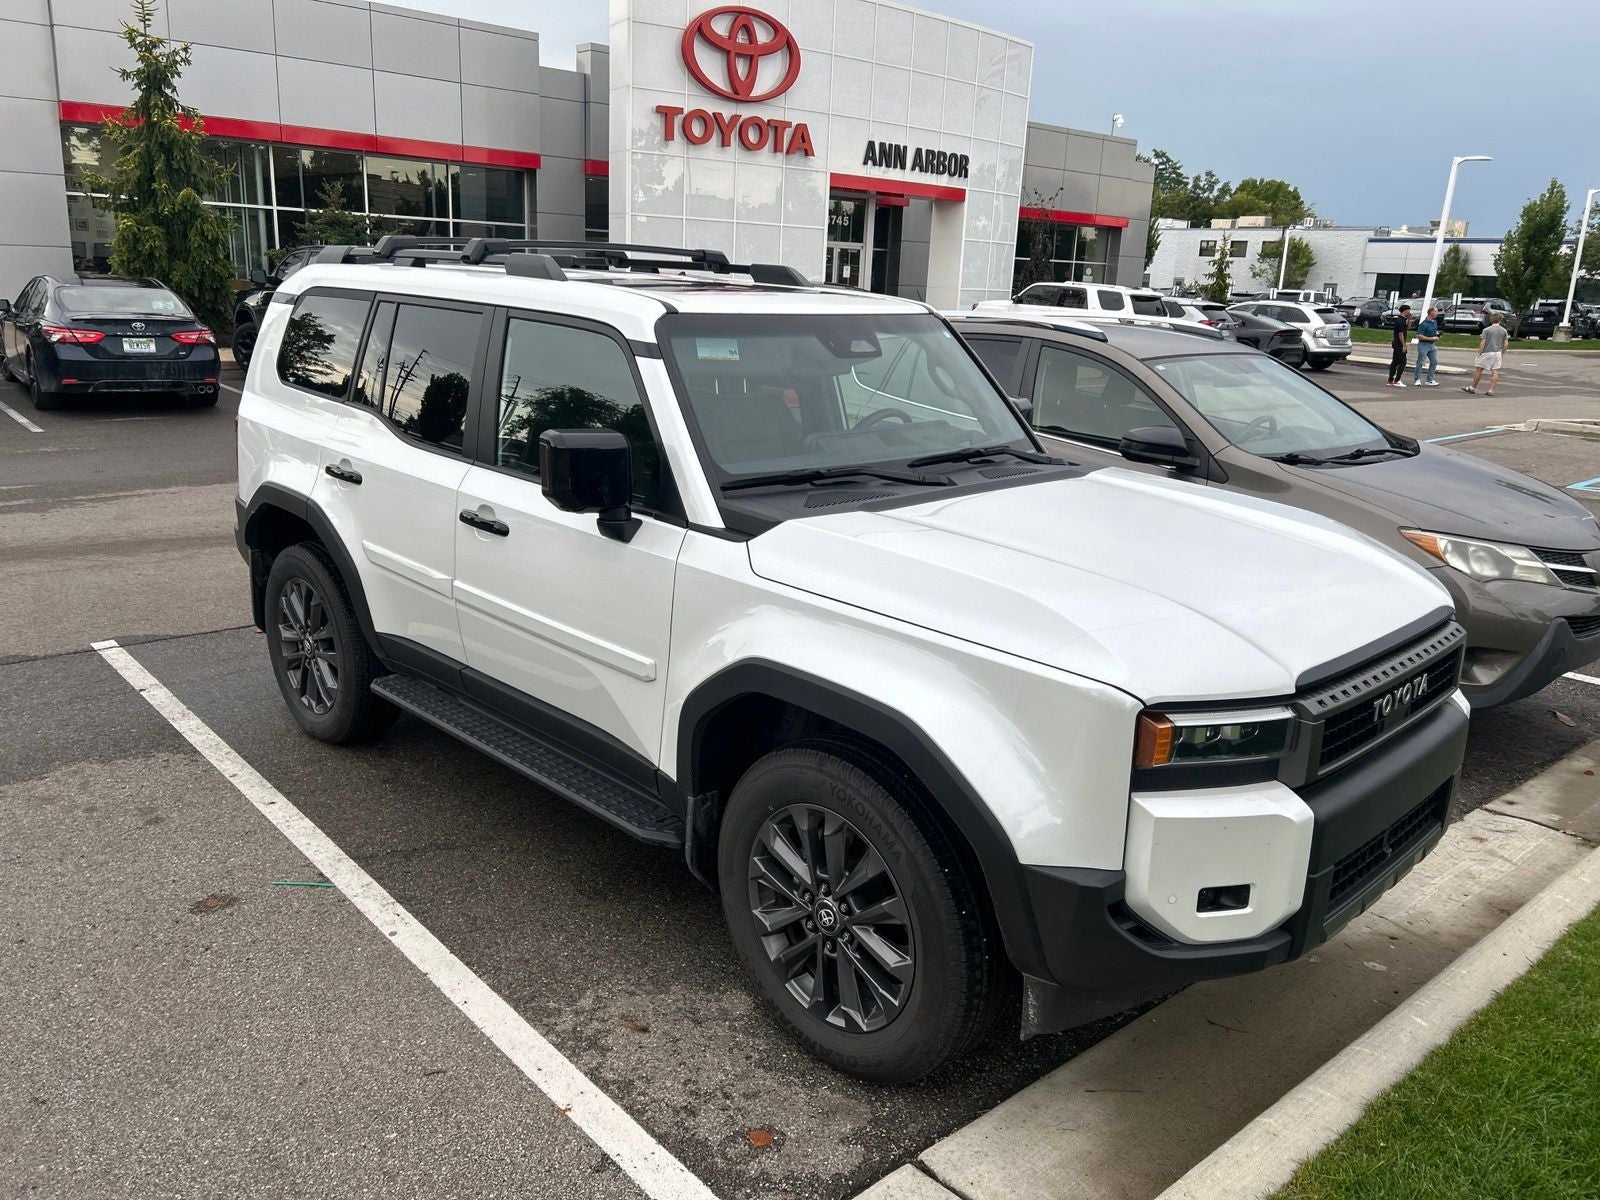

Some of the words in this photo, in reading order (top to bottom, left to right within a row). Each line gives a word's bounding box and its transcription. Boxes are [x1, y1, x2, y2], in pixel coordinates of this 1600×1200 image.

[655, 104, 815, 157] TOYOTA
[862, 140, 908, 170] ANN
[911, 147, 970, 178] ARBOR
[1373, 673, 1428, 721] TOYOTA
[830, 782, 902, 863] YOKOHAMA
